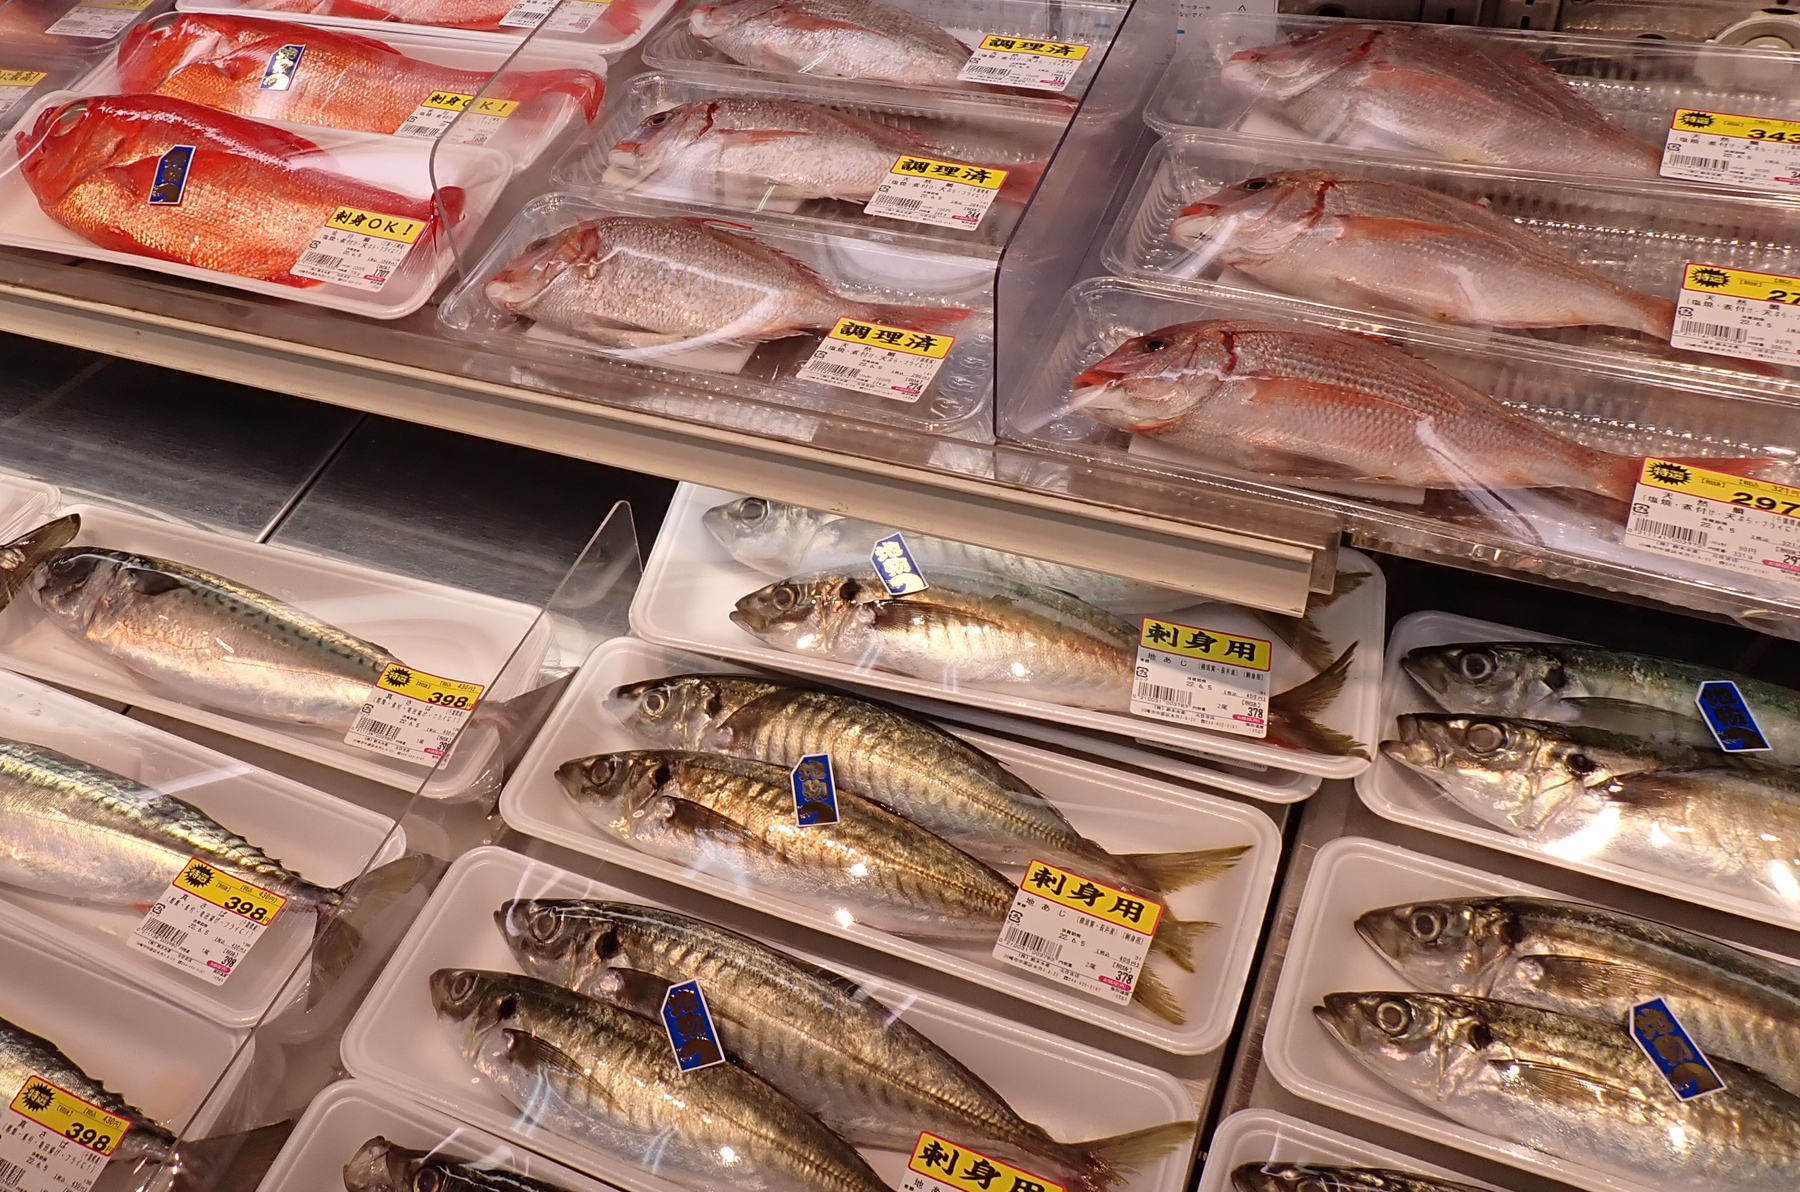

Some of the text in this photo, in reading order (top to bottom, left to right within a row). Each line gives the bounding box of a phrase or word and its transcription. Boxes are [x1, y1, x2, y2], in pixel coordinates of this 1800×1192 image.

[989, 37, 1075, 56] 調理済
[901, 158, 993, 184] 調理済
[333, 210, 414, 236] 刺身OK!
[839, 321, 938, 352] 調理済
[1730, 491, 1800, 515] 297
[1145, 622, 1257, 662] 刺身用
[428, 692, 469, 708] 398
[1246, 706, 1264, 719] 378
[1026, 897, 1066, 917] 地あじ
[1029, 866, 1145, 923] 刺身用
[224, 896, 267, 921] 398
[220, 954, 237, 968] 398
[1114, 969, 1134, 985] 378
[65, 1122, 111, 1151] 398
[918, 1140, 1046, 1192] 刺身用
